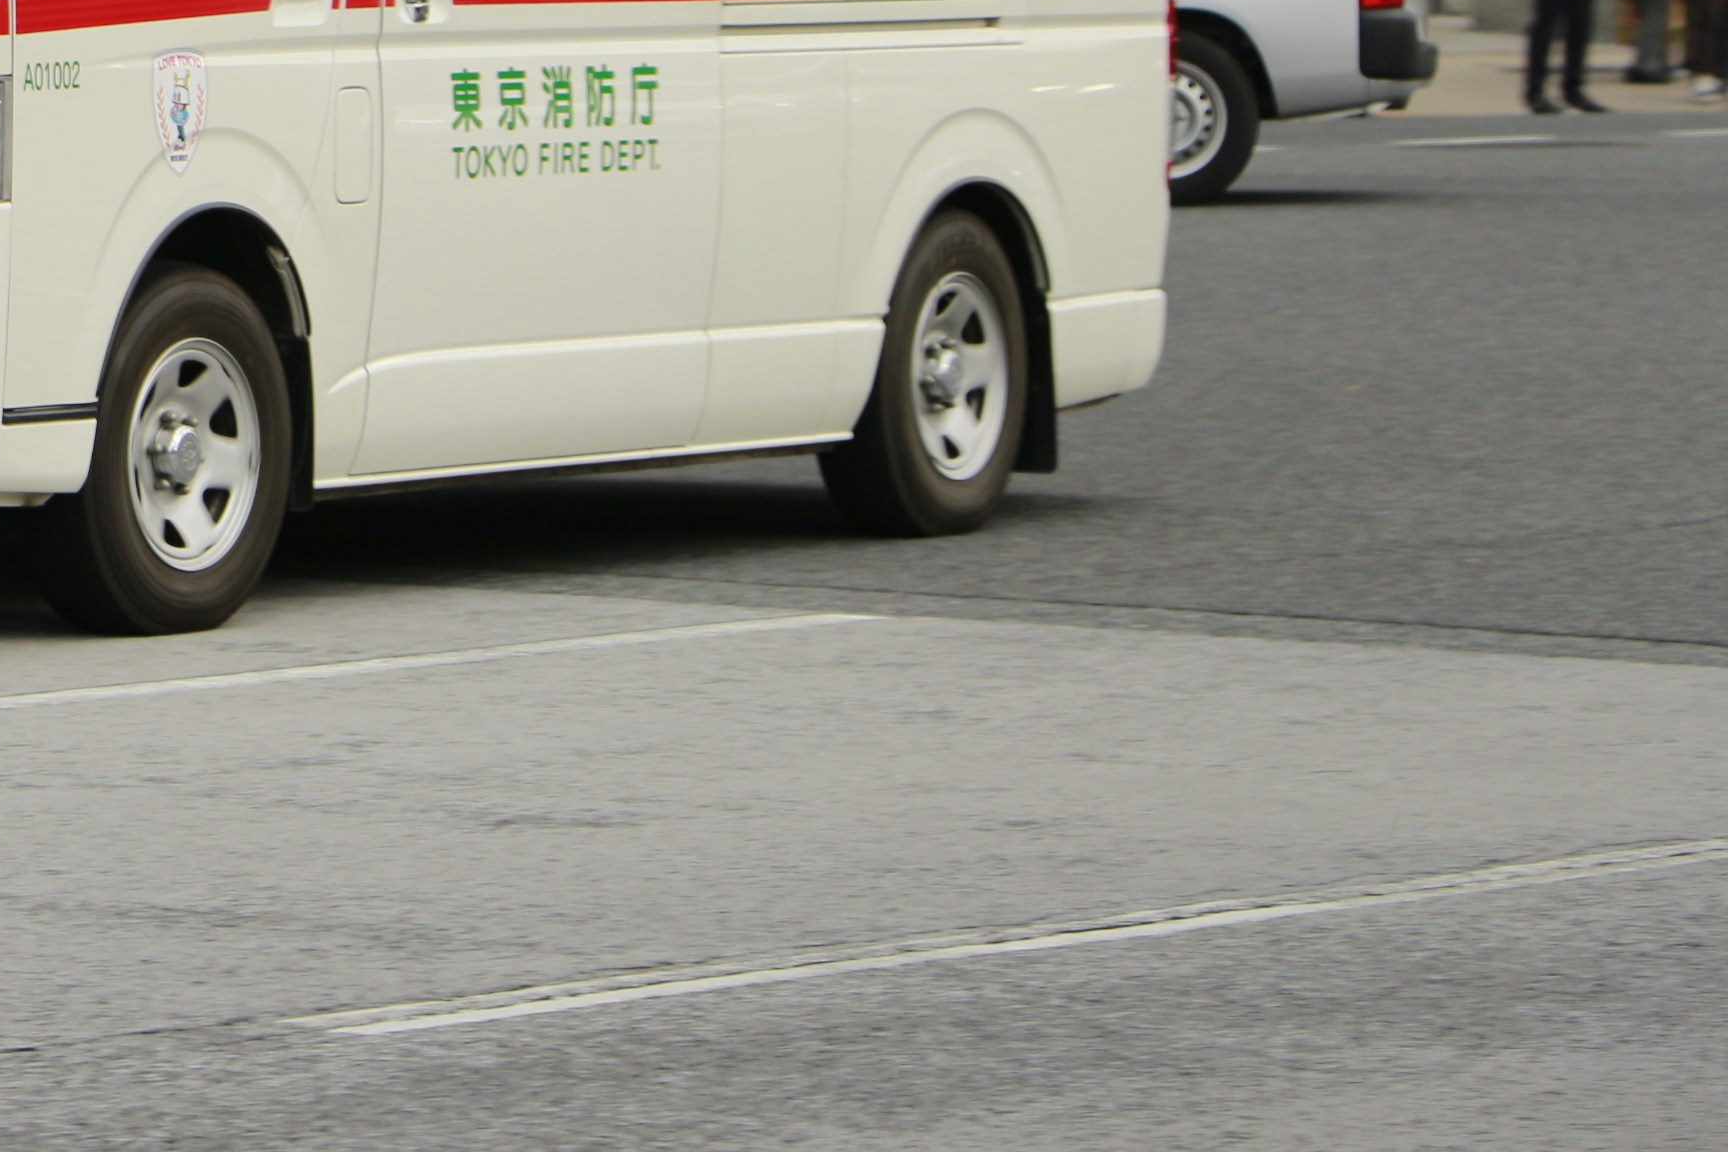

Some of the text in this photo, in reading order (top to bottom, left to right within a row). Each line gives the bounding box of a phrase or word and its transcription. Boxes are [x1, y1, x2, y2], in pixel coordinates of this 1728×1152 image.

[24, 60, 80, 91] A01002
[158, 54, 202, 71] LOVE TOKYO
[451, 63, 658, 132] 東京消防庁
[453, 138, 661, 179] TOKYO FIRE DEPT.
